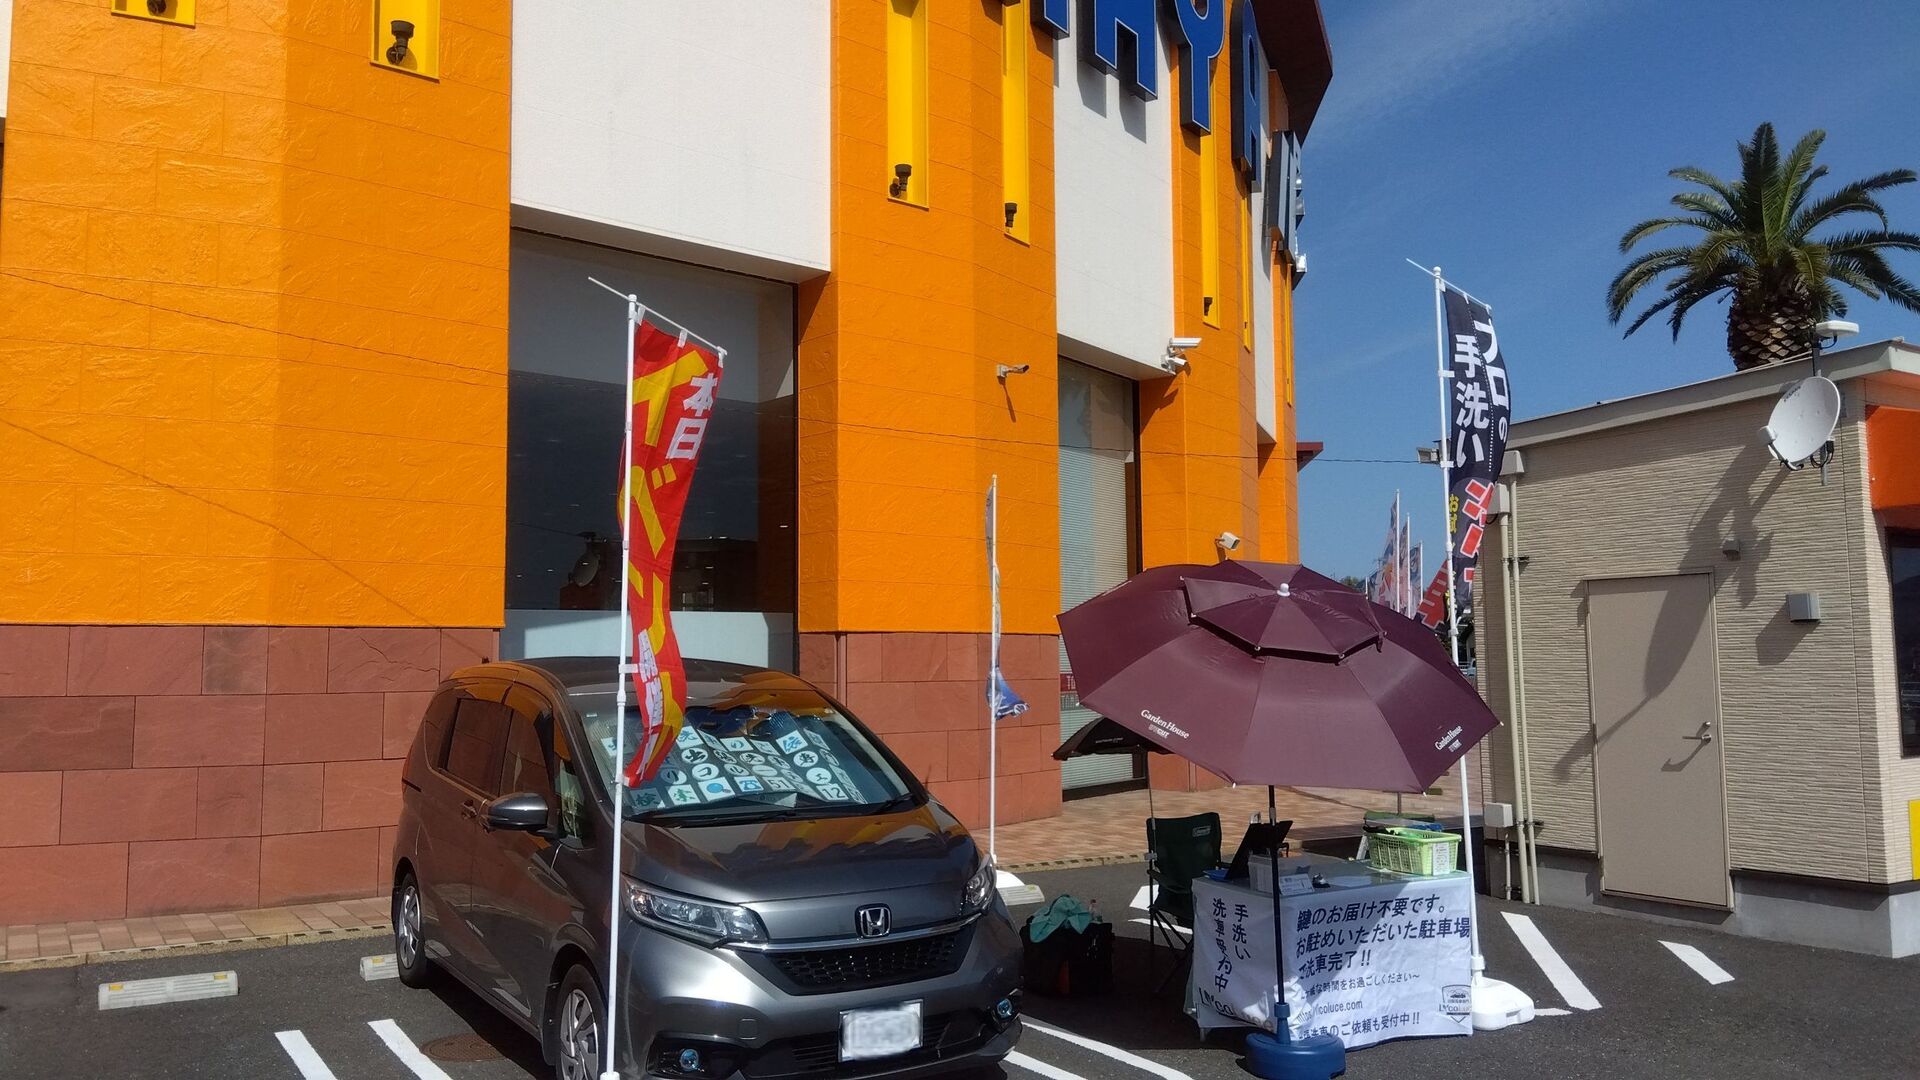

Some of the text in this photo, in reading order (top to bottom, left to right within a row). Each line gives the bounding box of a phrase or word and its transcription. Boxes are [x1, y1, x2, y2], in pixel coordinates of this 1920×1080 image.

[665, 373, 718, 460] 本日
[1455, 334, 1490, 468] 手洗い
[1141, 709, 1189, 739] Garden House
[1232, 904, 1251, 960] 手洗い
[1297, 894, 1446, 932] 鍵のお届け不要です。
